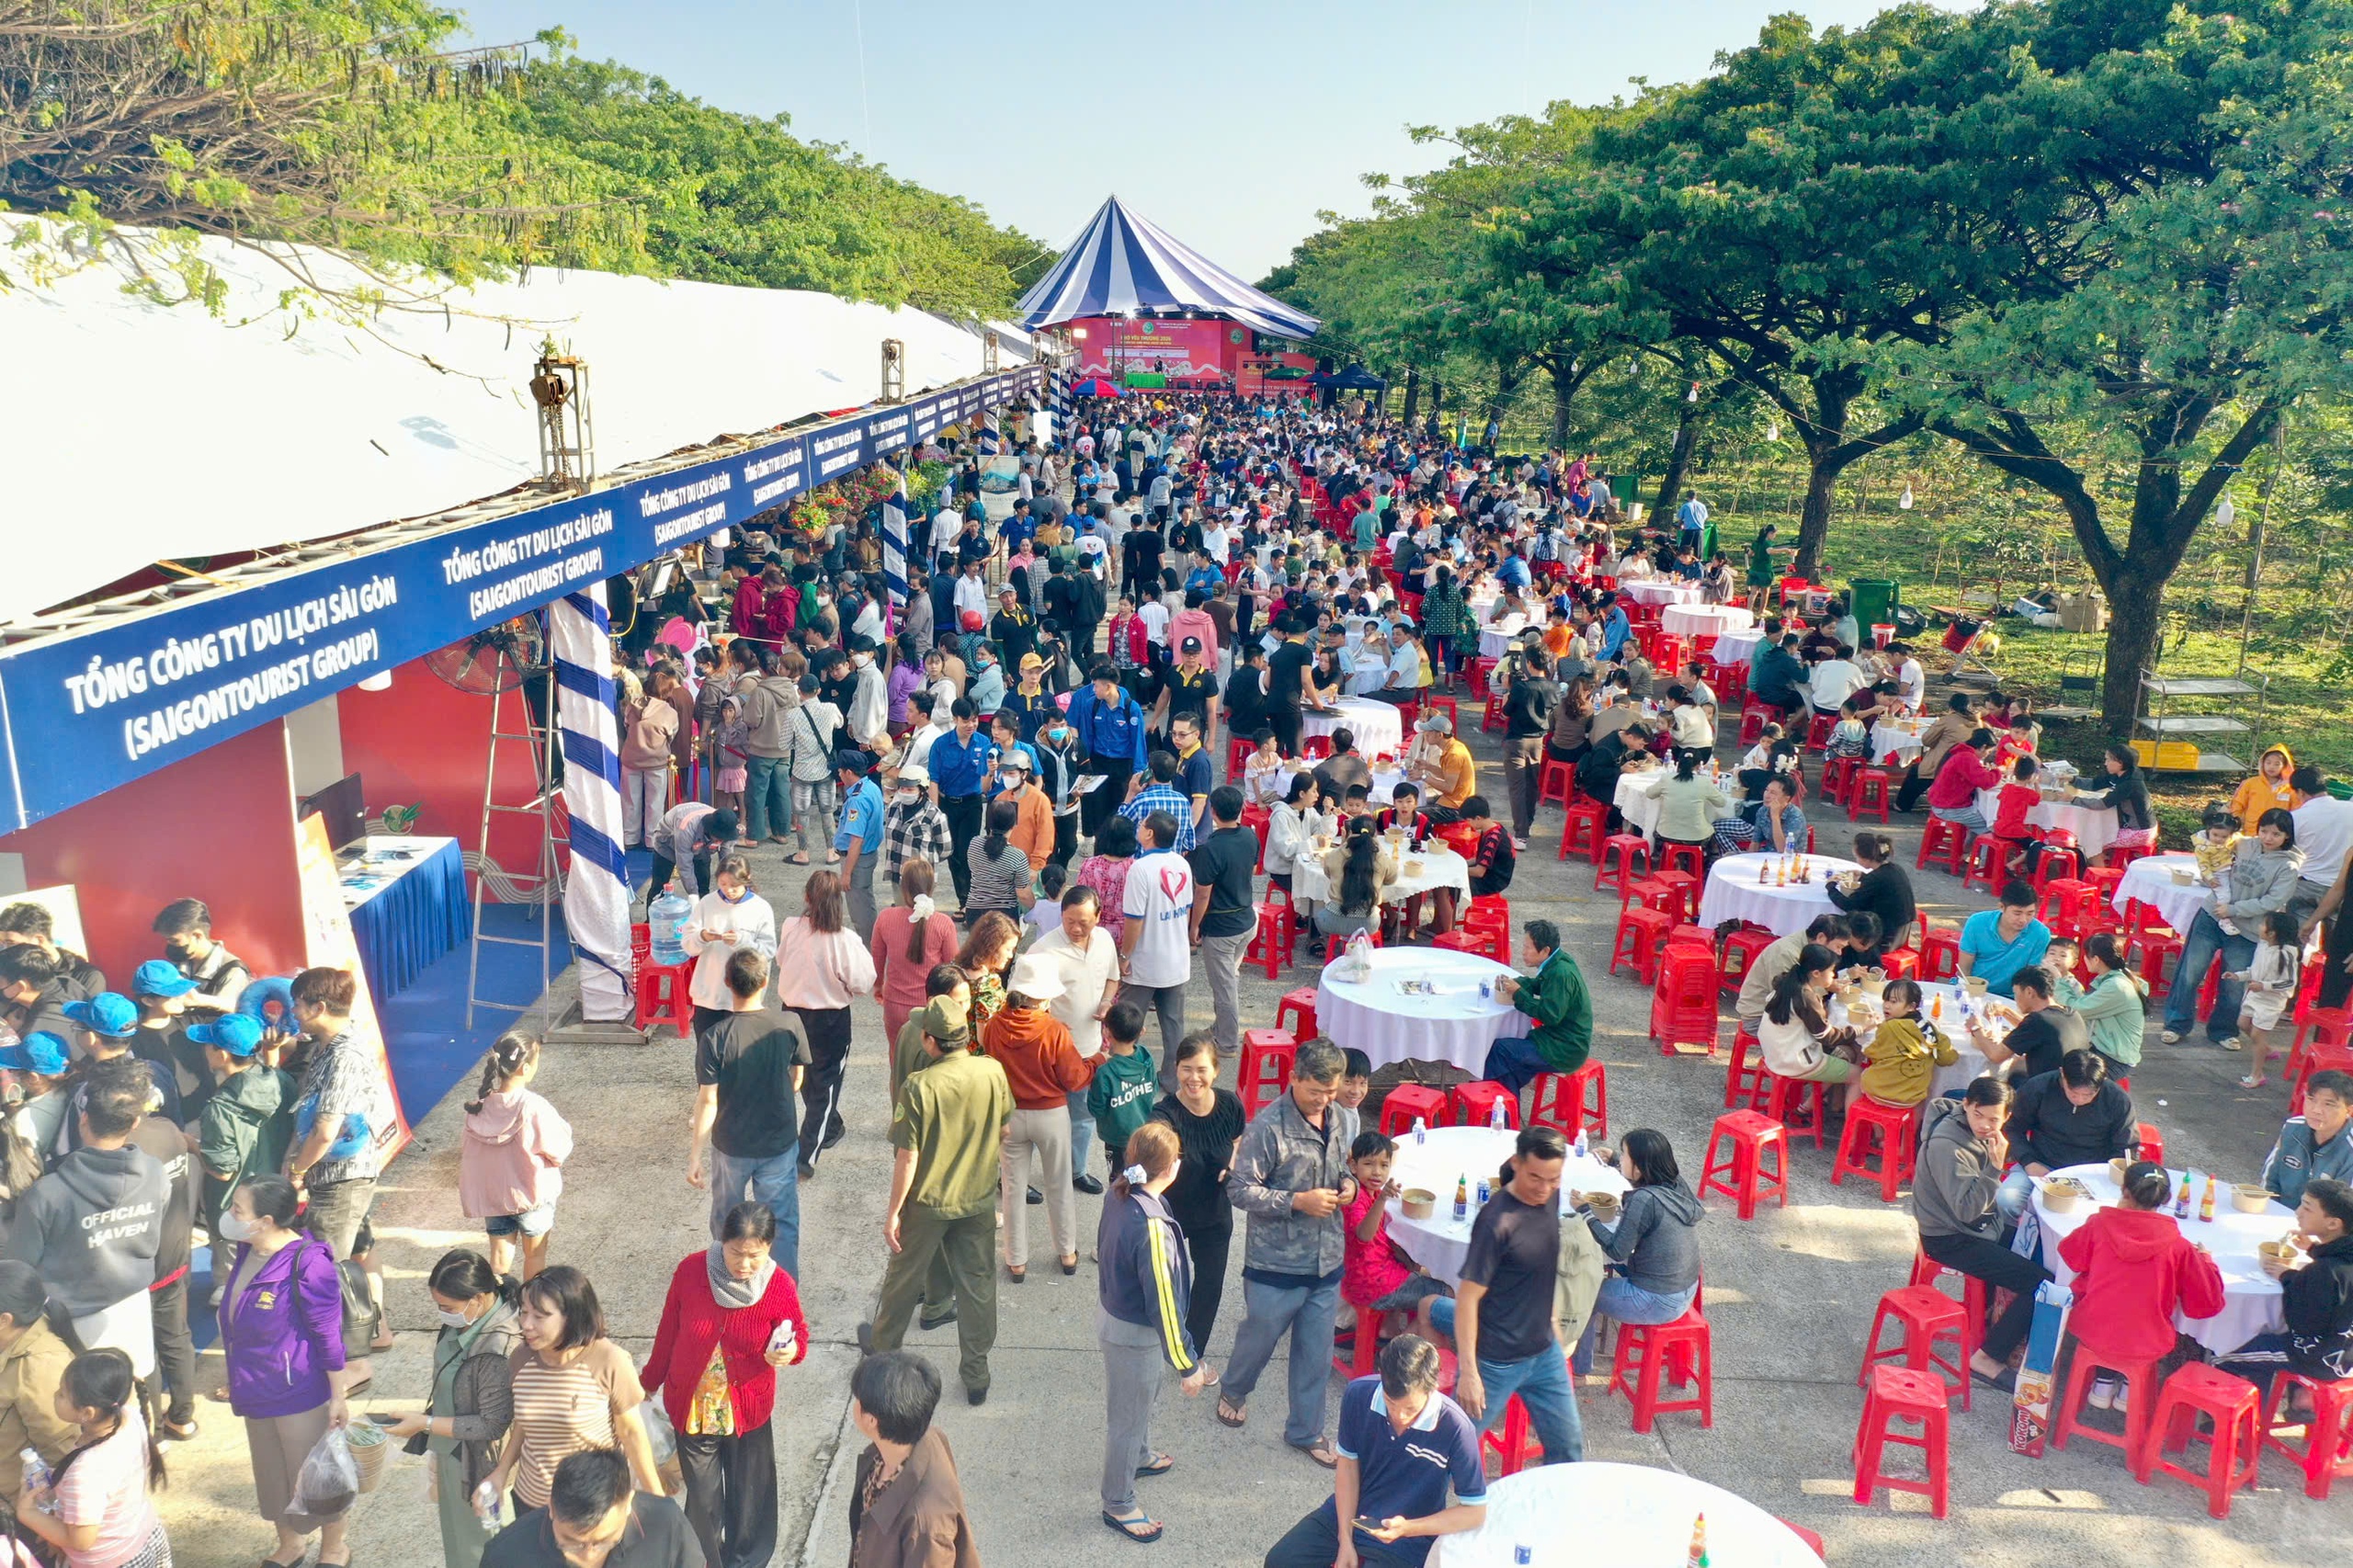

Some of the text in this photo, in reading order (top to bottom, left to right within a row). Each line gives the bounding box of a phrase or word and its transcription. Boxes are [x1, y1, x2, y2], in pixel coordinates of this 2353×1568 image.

[443, 508, 613, 585] TỔNG CÔNG TY DU LỊCH SÀI GÒN
[470, 546, 602, 620] (SAIGONTOURIST GROUP)
[65, 574, 397, 714] TỔNG CÔNG TY DU LỊCH SÀI GÒN
[125, 628, 379, 760] (SAIGONTOURIST GROUP)
[81, 1201, 155, 1230] OFFICIAL
[87, 1221, 149, 1249] HAVEN
[2014, 1410, 2030, 1450] KOKOMI
[2029, 1425, 2039, 1437] 90
